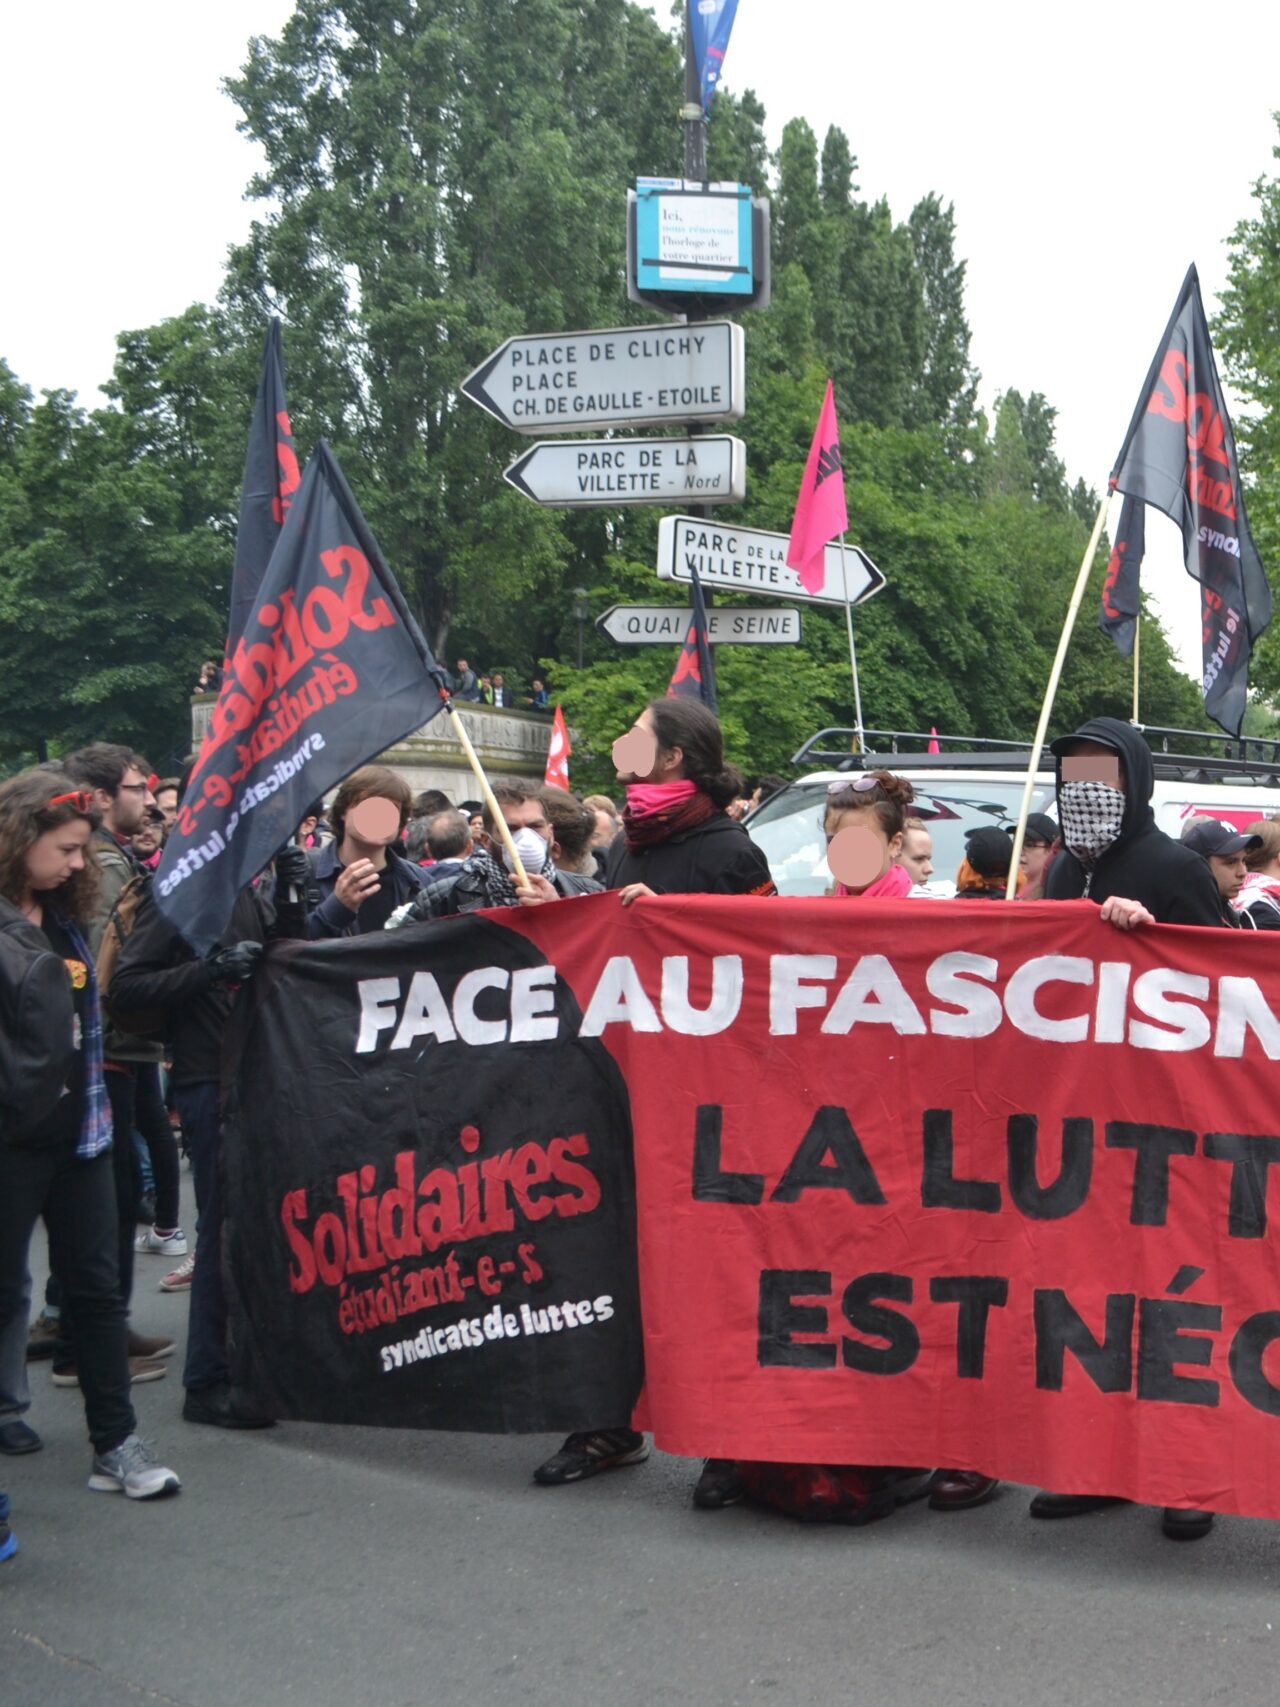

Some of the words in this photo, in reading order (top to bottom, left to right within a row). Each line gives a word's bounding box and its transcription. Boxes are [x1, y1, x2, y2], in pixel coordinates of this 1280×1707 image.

[662, 208, 683, 222] Ici,
[662, 252, 689, 260] votre
[691, 253, 734, 264] quartier
[707, 238, 720, 248] de
[511, 346, 578, 367] PLACE
[589, 343, 616, 361] DE
[627, 335, 706, 359] CLICHY
[511, 371, 578, 392] PLACE
[512, 398, 541, 416] CH.
[545, 396, 568, 414] DE
[572, 391, 643, 413] GAULLE
[657, 385, 722, 407] ETOILE
[577, 451, 626, 470] PARC
[638, 450, 663, 467] DE
[674, 449, 698, 466] LA
[577, 473, 661, 492] VILLETTE
[683, 474, 721, 489] Nord
[684, 529, 738, 553] PARC
[747, 545, 764, 559] DE
[769, 549, 785, 562] LA
[684, 552, 780, 583] VILLETTE
[627, 616, 680, 634] QUAI
[732, 616, 792, 634] SEINE
[355, 965, 560, 1054] FACE
[578, 954, 744, 1038] AU
[691, 1103, 889, 1205] LA
[281, 1124, 602, 1294] Solidaires
[519, 1294, 615, 1337] luttes
[756, 1267, 1010, 1380] EST
